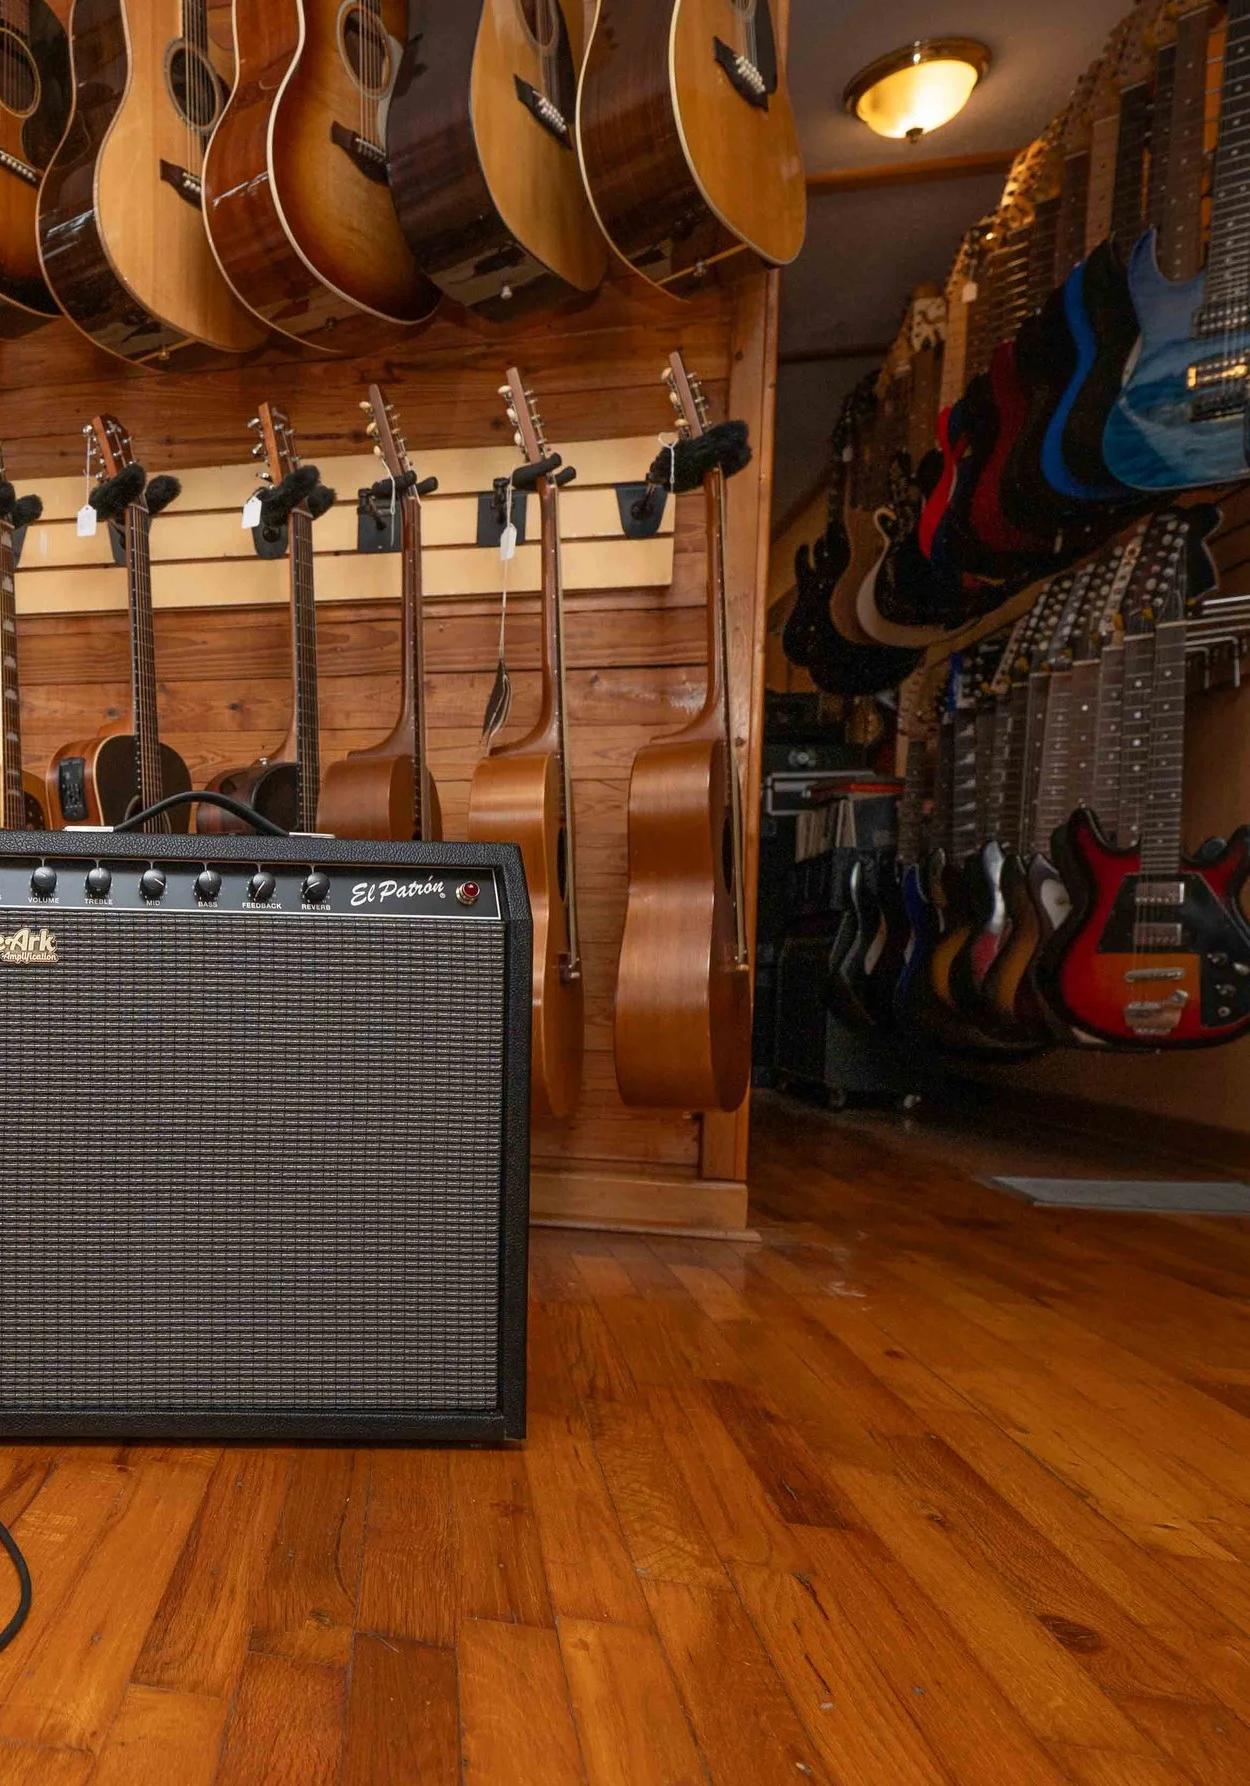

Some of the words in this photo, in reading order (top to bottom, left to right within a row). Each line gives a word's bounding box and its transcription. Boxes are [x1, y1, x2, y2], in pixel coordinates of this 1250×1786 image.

[350, 882, 376, 907] El
[378, 875, 445, 903] Patrón
[27, 896, 60, 904] VOLUME
[1, 951, 58, 964] Amplification
